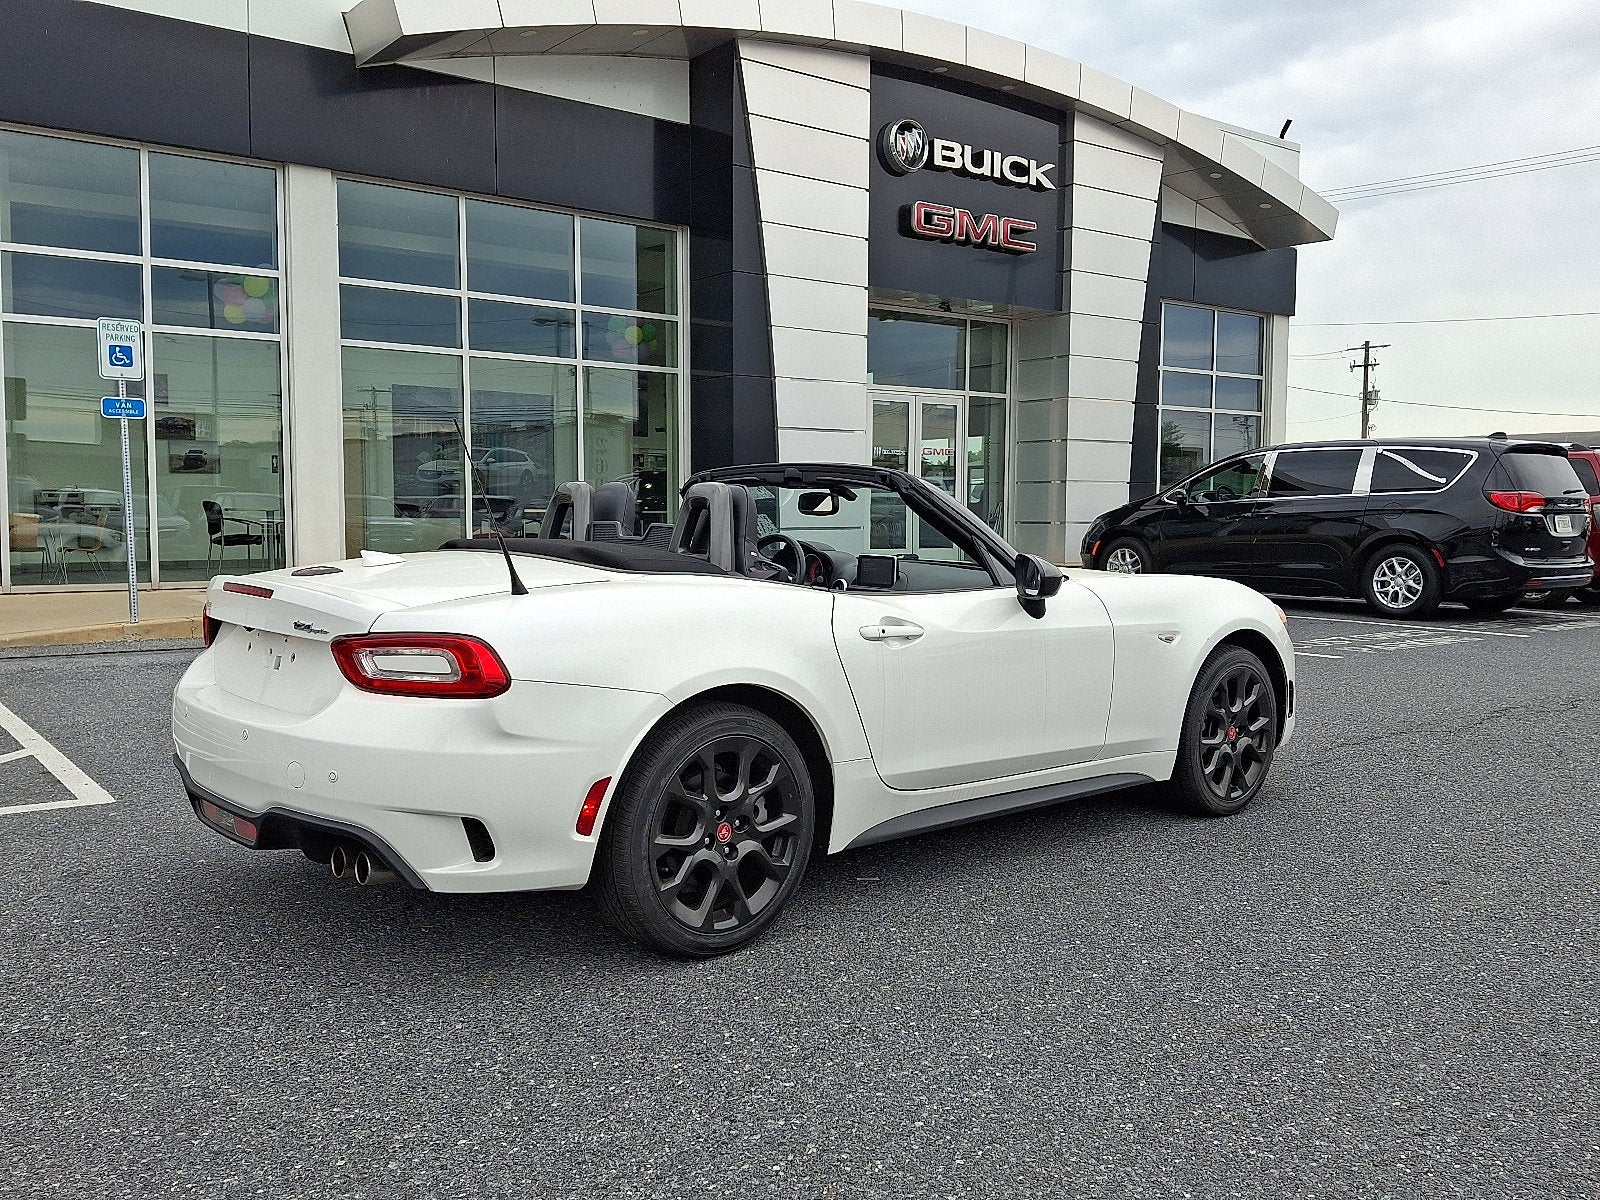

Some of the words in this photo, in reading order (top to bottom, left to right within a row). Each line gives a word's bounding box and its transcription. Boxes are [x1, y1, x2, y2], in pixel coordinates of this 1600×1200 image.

[933, 138, 1056, 190] BUICK
[913, 200, 1037, 252] GMC
[101, 322, 139, 333] RESERVED
[105, 333, 136, 343] PARKING
[922, 447, 954, 456] GMC
